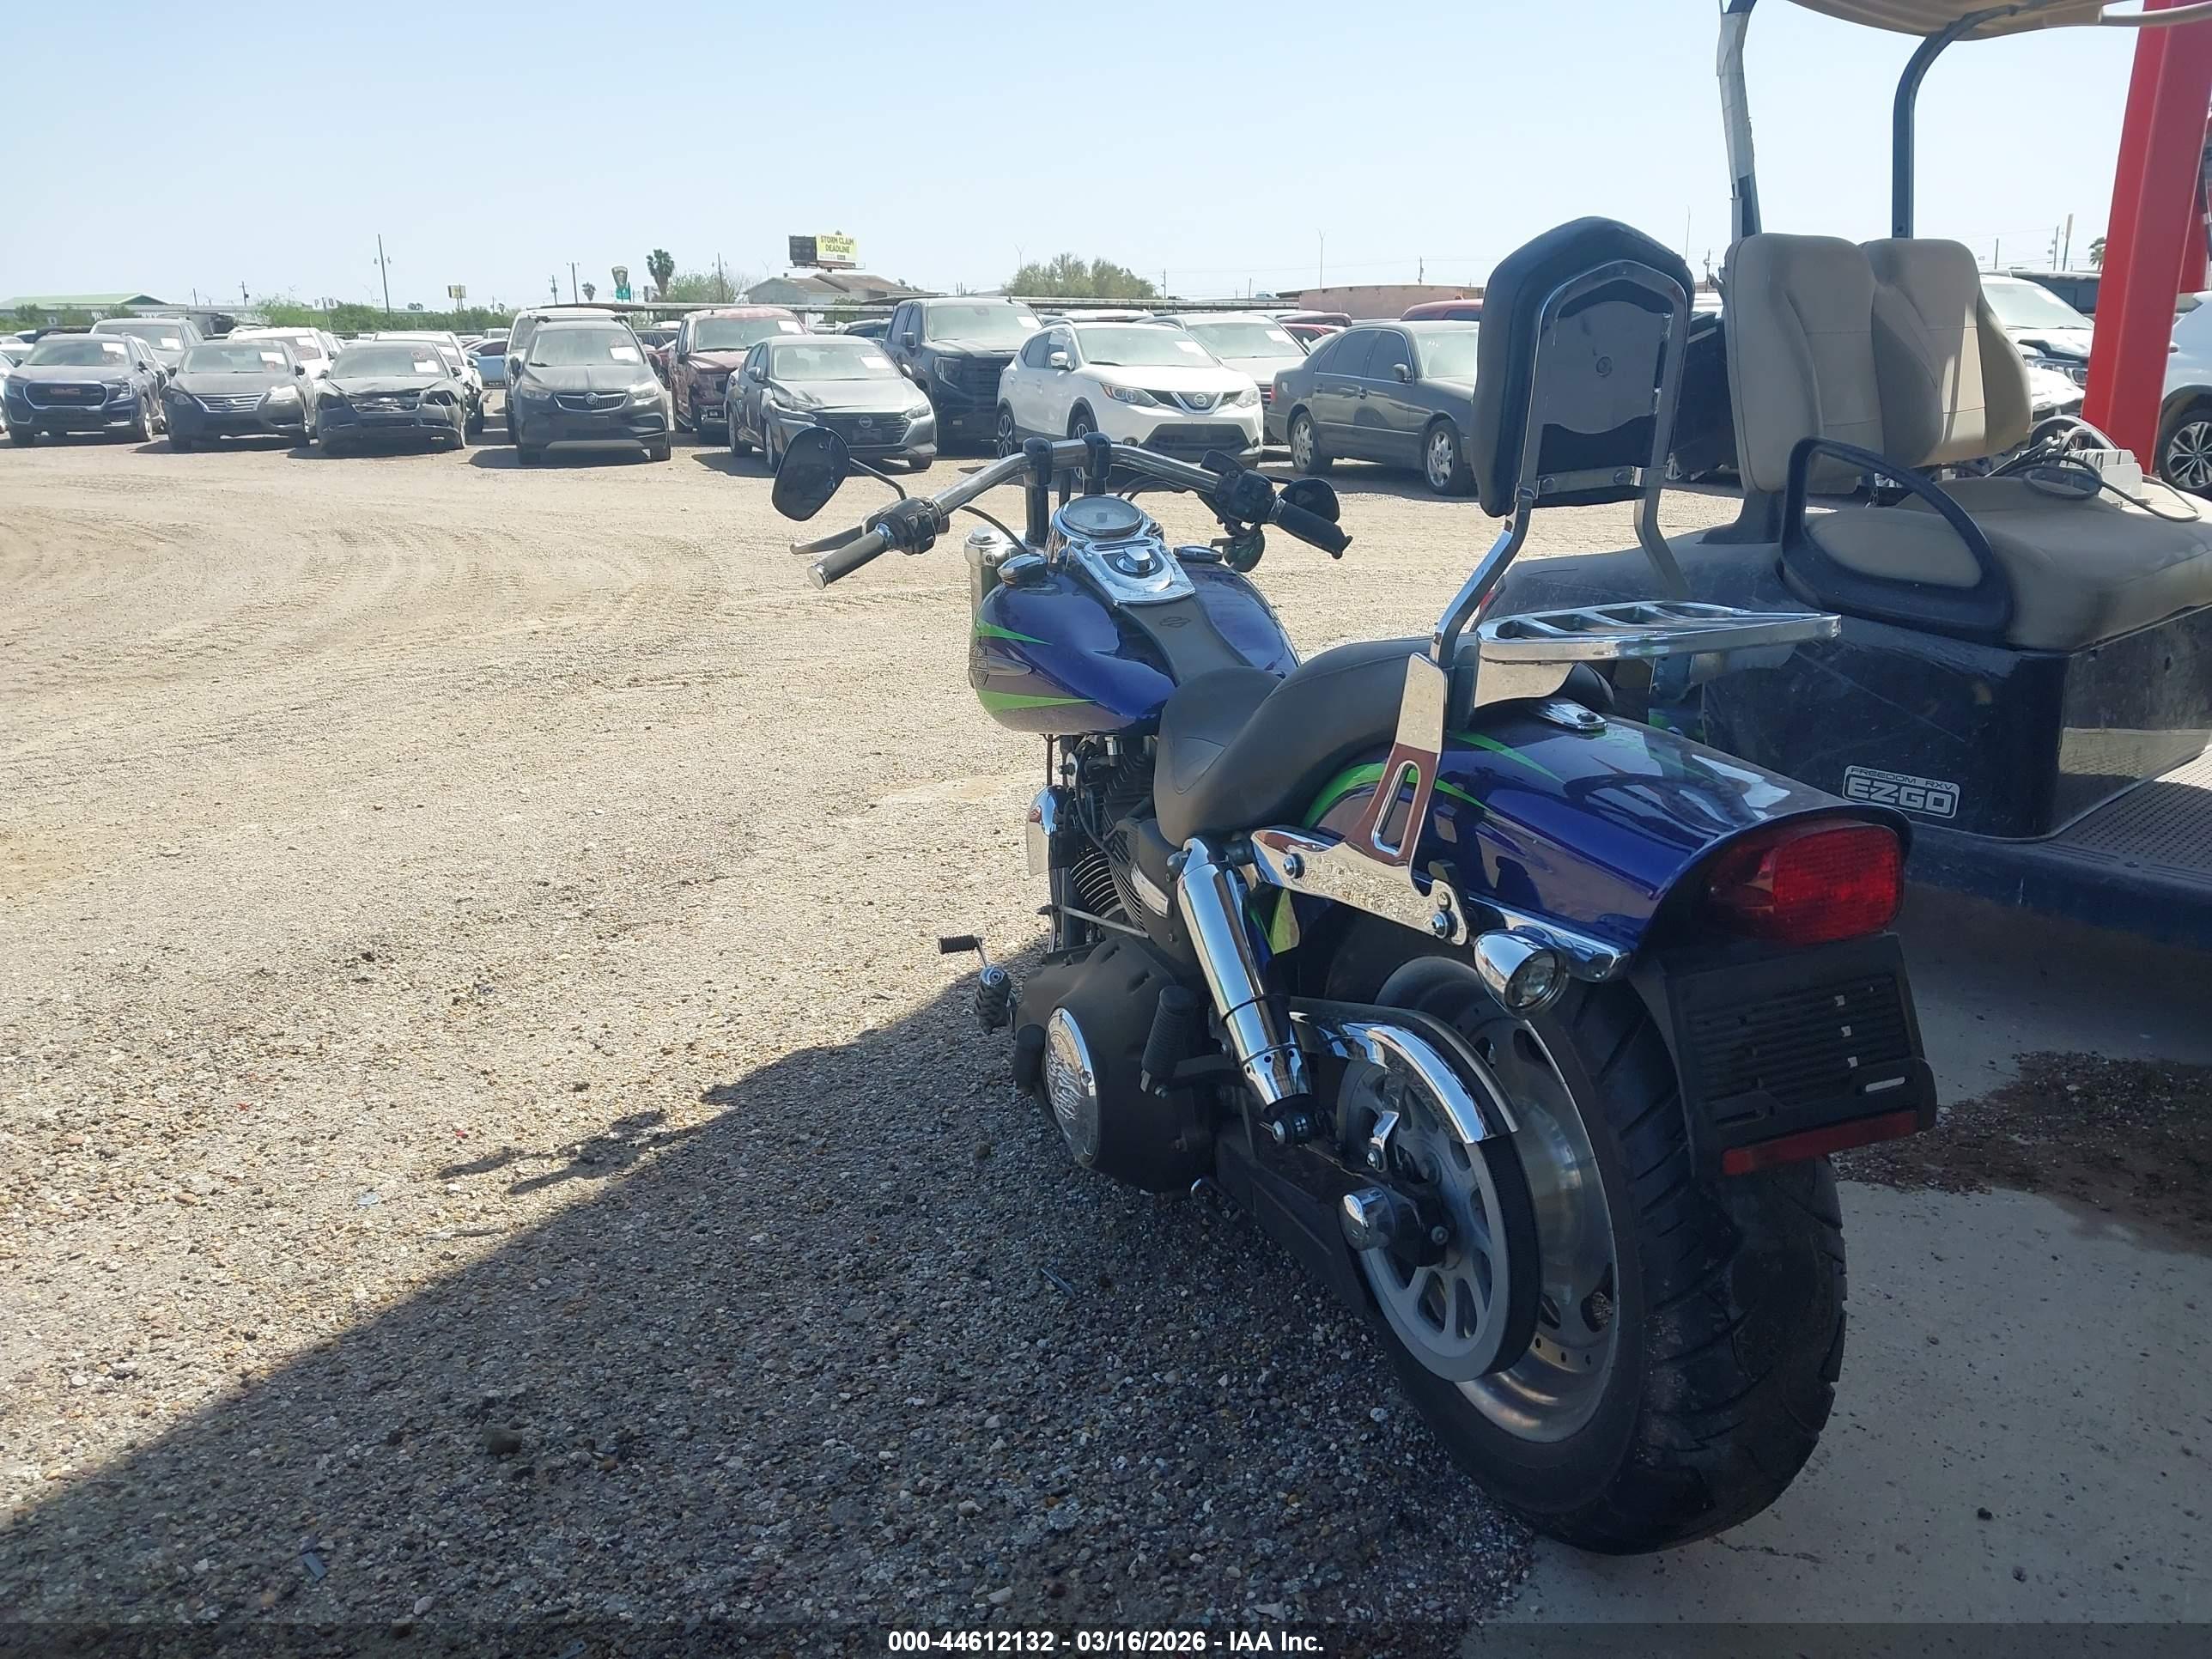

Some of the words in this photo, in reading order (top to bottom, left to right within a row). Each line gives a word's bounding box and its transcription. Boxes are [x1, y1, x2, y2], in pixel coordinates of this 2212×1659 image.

[821, 235, 838, 245] STORM
[839, 236, 854, 246] CLAIM
[825, 244, 850, 253] DEADLINE
[1850, 767, 1917, 784] FREEDOM
[1924, 780, 1954, 791] RXV
[1847, 776, 1953, 814] EZGO
